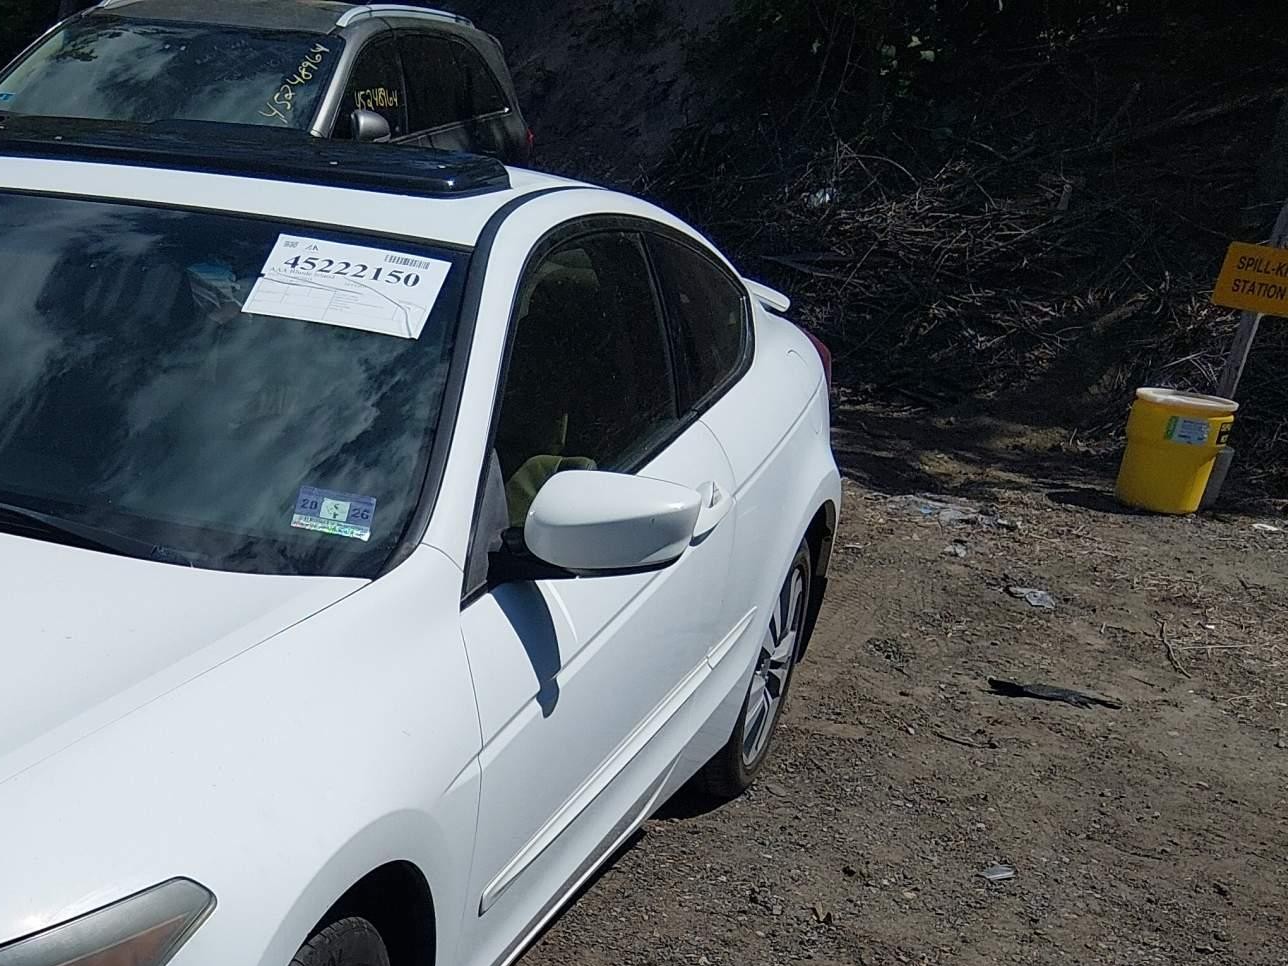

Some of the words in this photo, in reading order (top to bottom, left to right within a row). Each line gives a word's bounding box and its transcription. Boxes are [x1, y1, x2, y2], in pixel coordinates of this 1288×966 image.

[258, 43, 330, 124] 45248964
[283, 255, 421, 288] 45222150
[1232, 278, 1287, 300] STATION
[352, 508, 369, 520] 26
